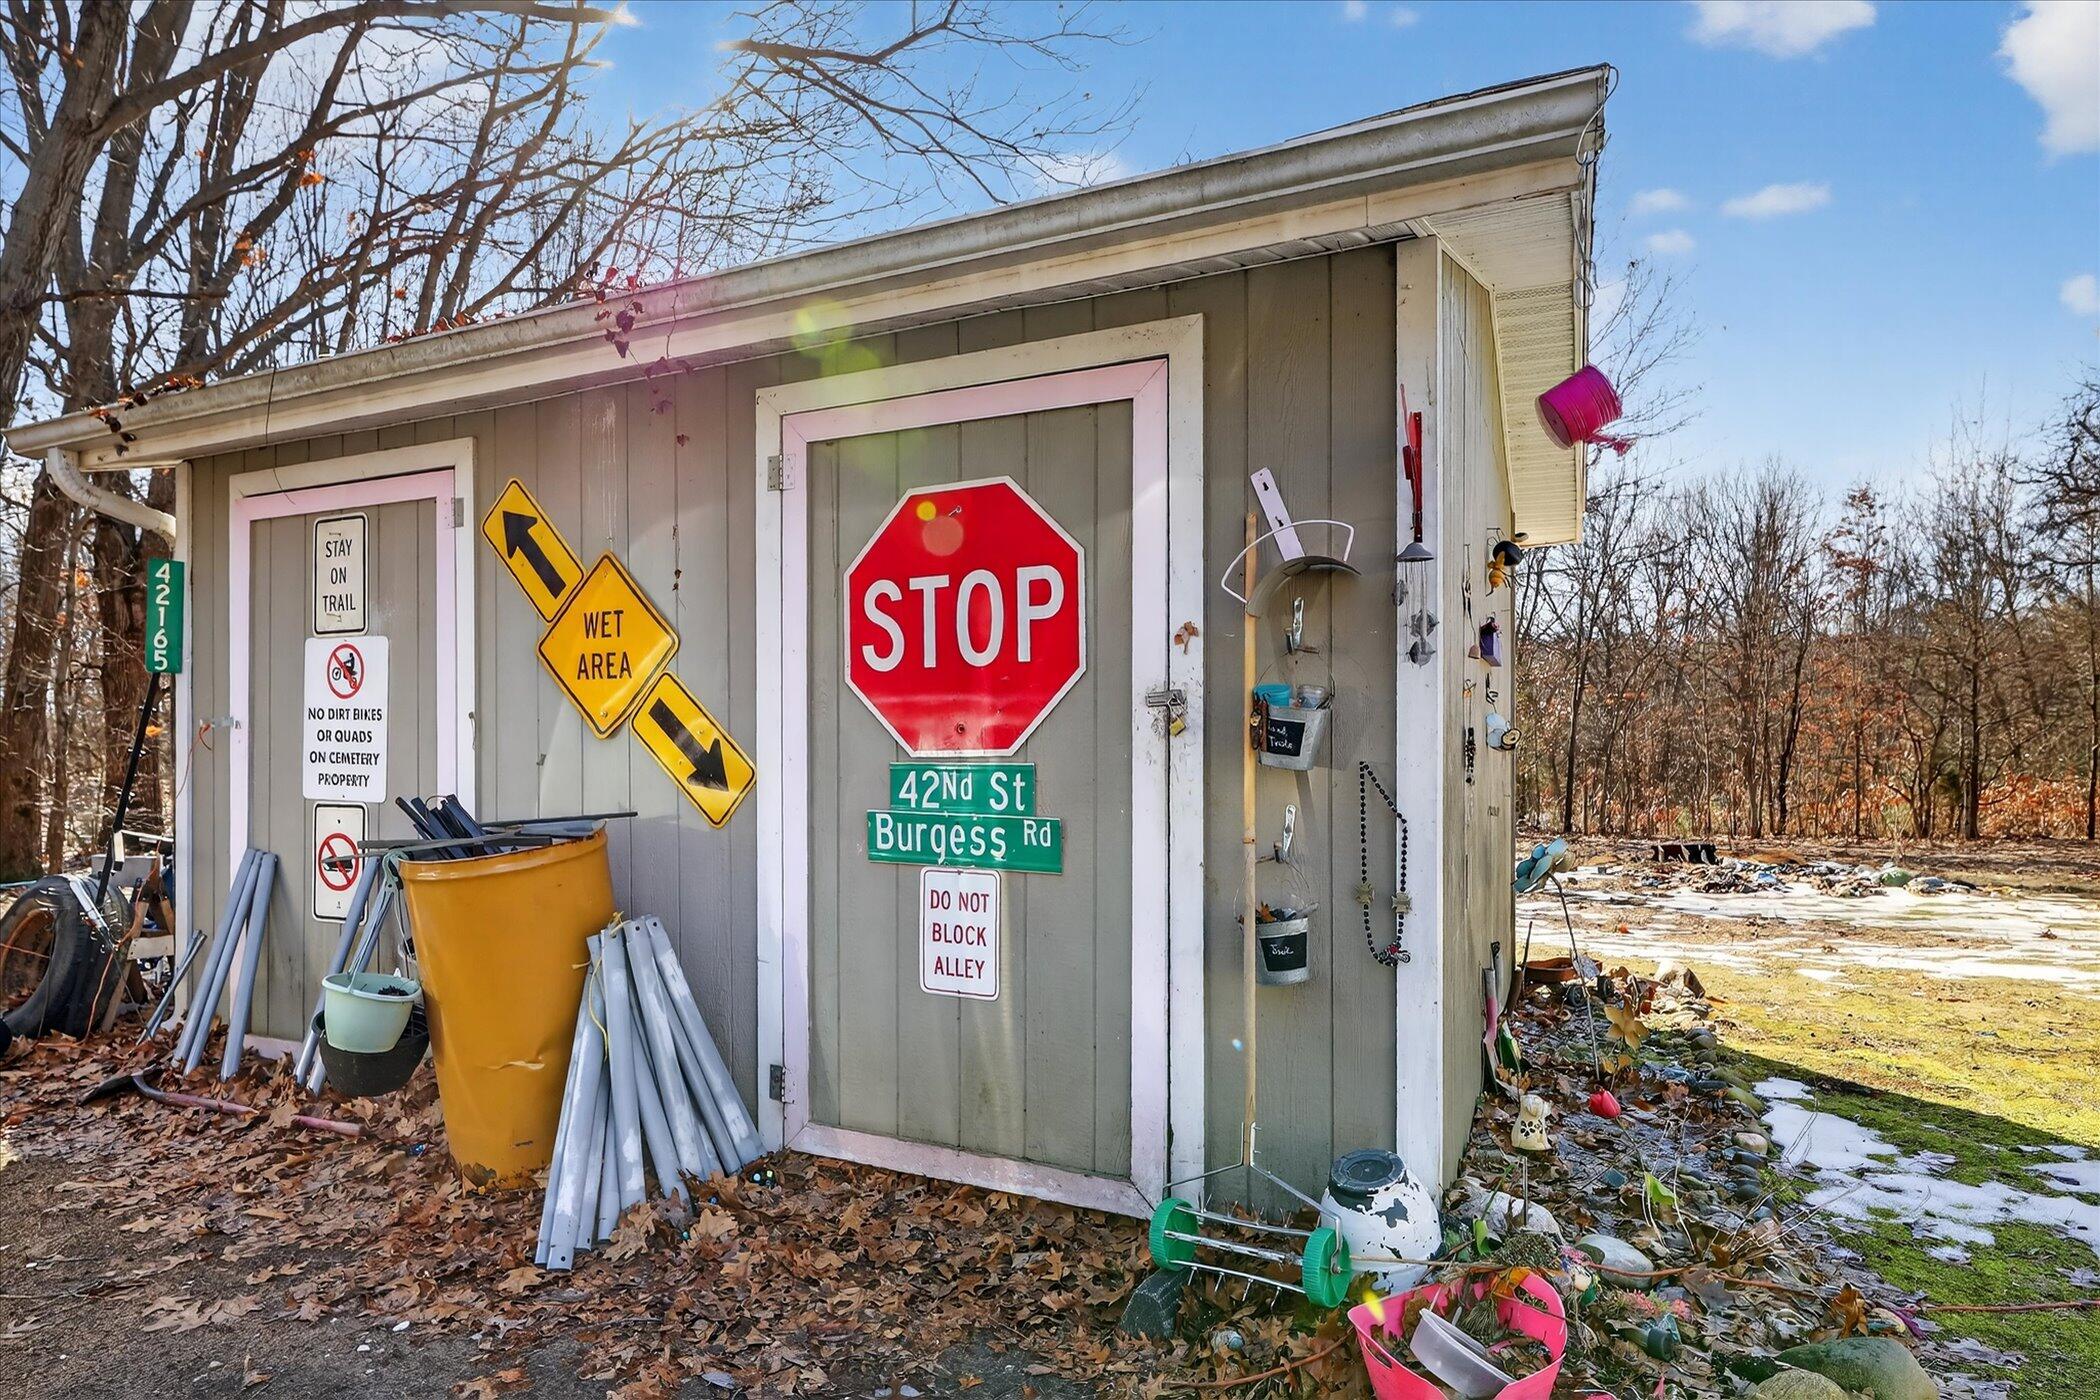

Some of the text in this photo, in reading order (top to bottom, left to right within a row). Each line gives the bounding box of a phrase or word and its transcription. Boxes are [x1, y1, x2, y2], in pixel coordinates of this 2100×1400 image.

[325, 538, 353, 558] STAY
[330, 566, 347, 585] ON
[322, 593, 356, 613] TRAIL
[153, 562, 171, 671] 42165
[583, 609, 624, 639] WET
[862, 564, 1065, 673] STOP
[577, 651, 632, 680] AREA
[308, 707, 383, 721] NO DIRT BIKES
[317, 729, 373, 743] OR QUADS
[309, 750, 380, 766] ON CEMETERY
[318, 772, 370, 787] PROPERTY
[898, 770, 1026, 811] 42Nd St
[875, 813, 1052, 865] Burgess Rd
[930, 889, 990, 913] DO NOT
[932, 922, 987, 947] BLOCK
[934, 955, 986, 980] ALLEY
